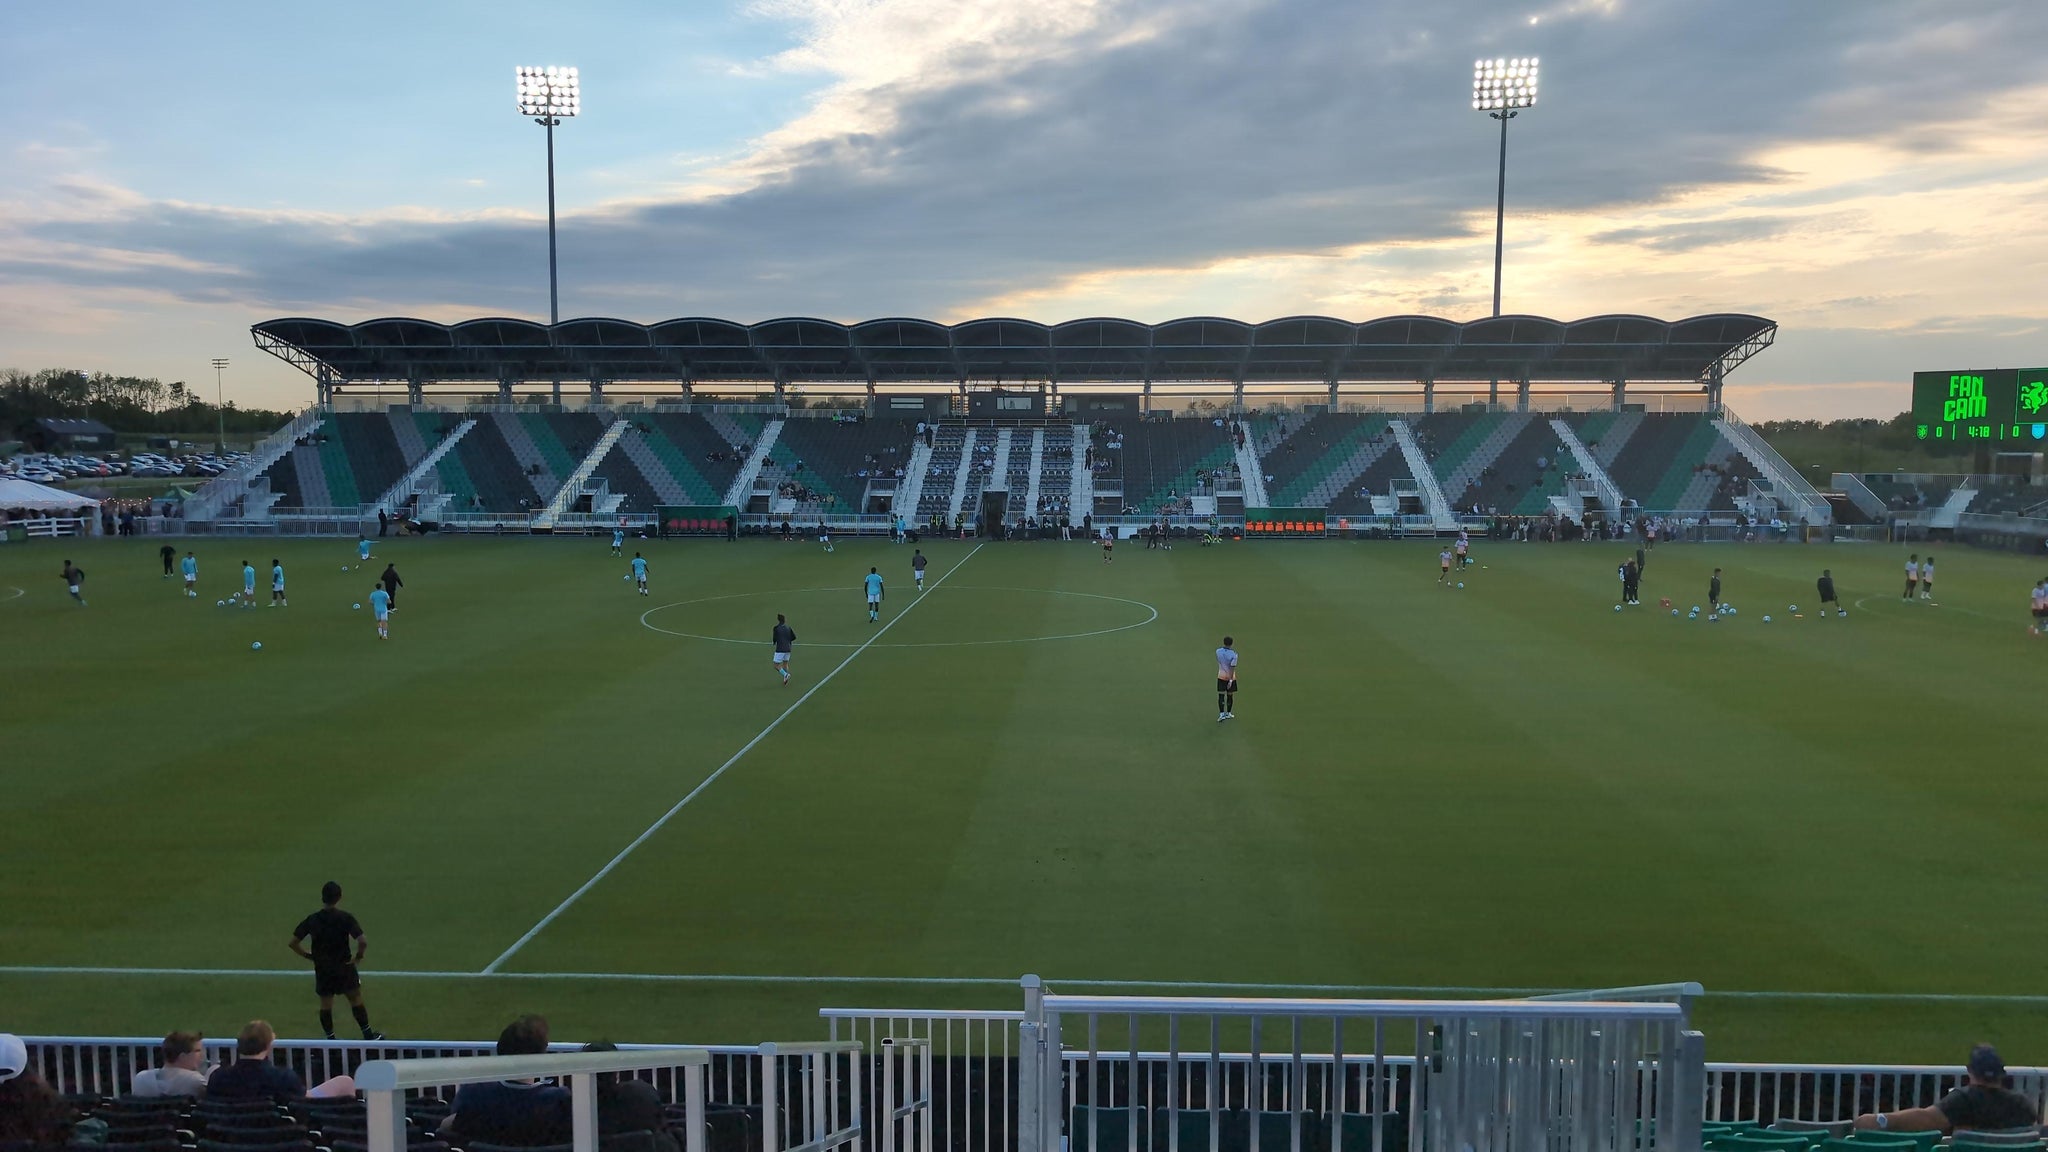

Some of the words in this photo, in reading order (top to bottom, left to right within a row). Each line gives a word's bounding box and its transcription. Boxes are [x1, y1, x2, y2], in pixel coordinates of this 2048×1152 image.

[1949, 375, 1984, 397] FAN
[1944, 396, 1987, 421] CAM
[1936, 426, 1942, 438] 0
[1968, 426, 1990, 438] 4:18
[2012, 426, 2020, 437] 0
